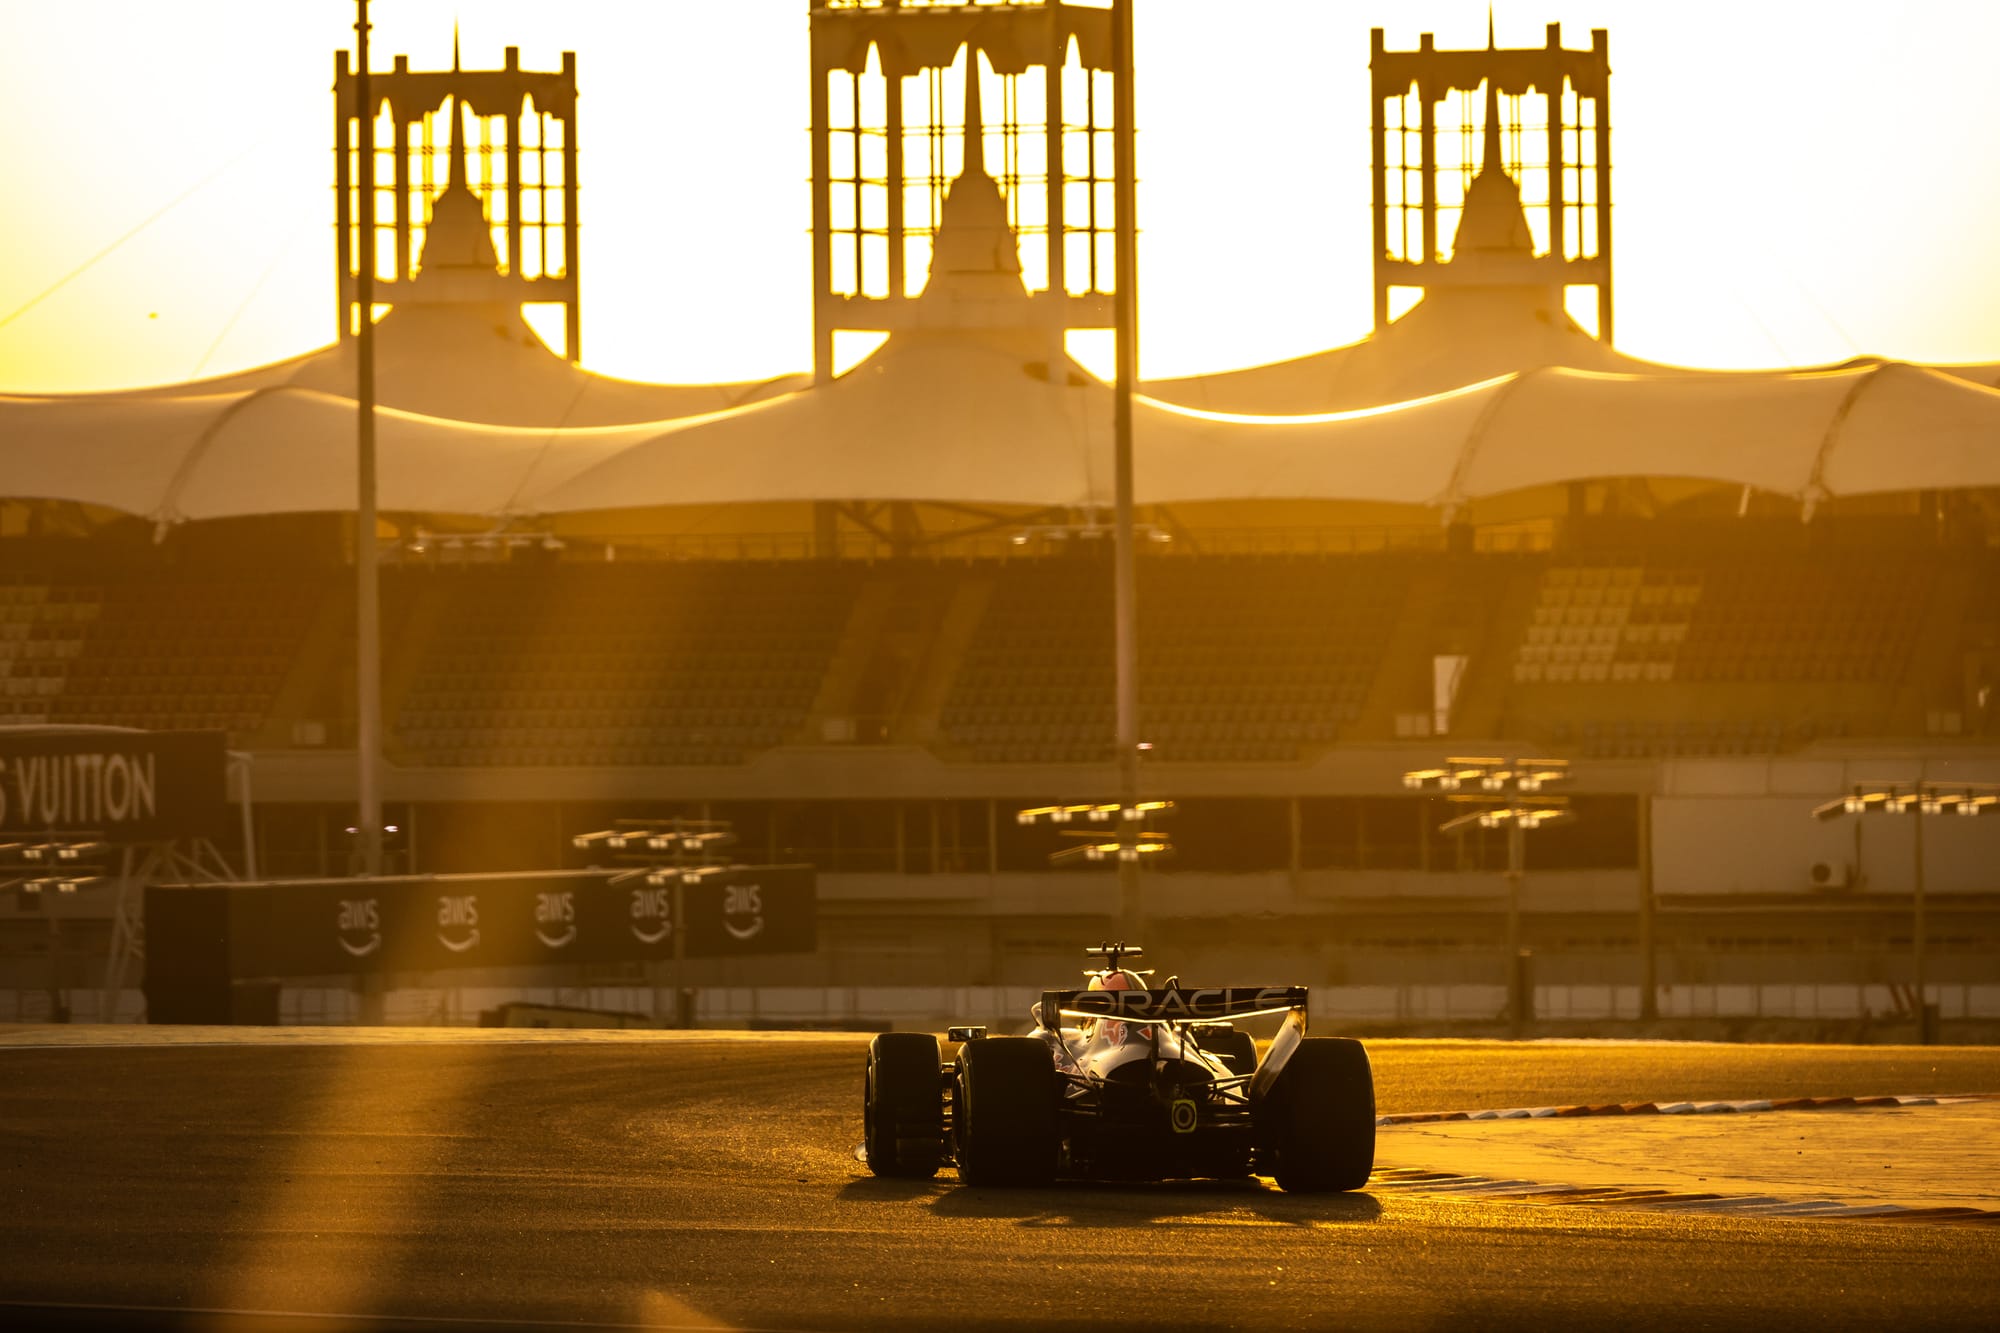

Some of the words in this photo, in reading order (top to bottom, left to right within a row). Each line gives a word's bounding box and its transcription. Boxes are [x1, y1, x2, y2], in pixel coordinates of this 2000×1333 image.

[15, 753, 156, 824] VUITTON
[438, 896, 478, 925] aws
[535, 892, 574, 921] aws
[630, 889, 669, 917] aws
[724, 885, 762, 913] aws
[337, 900, 379, 929] aws
[1071, 988, 1290, 1016] ORACLE
